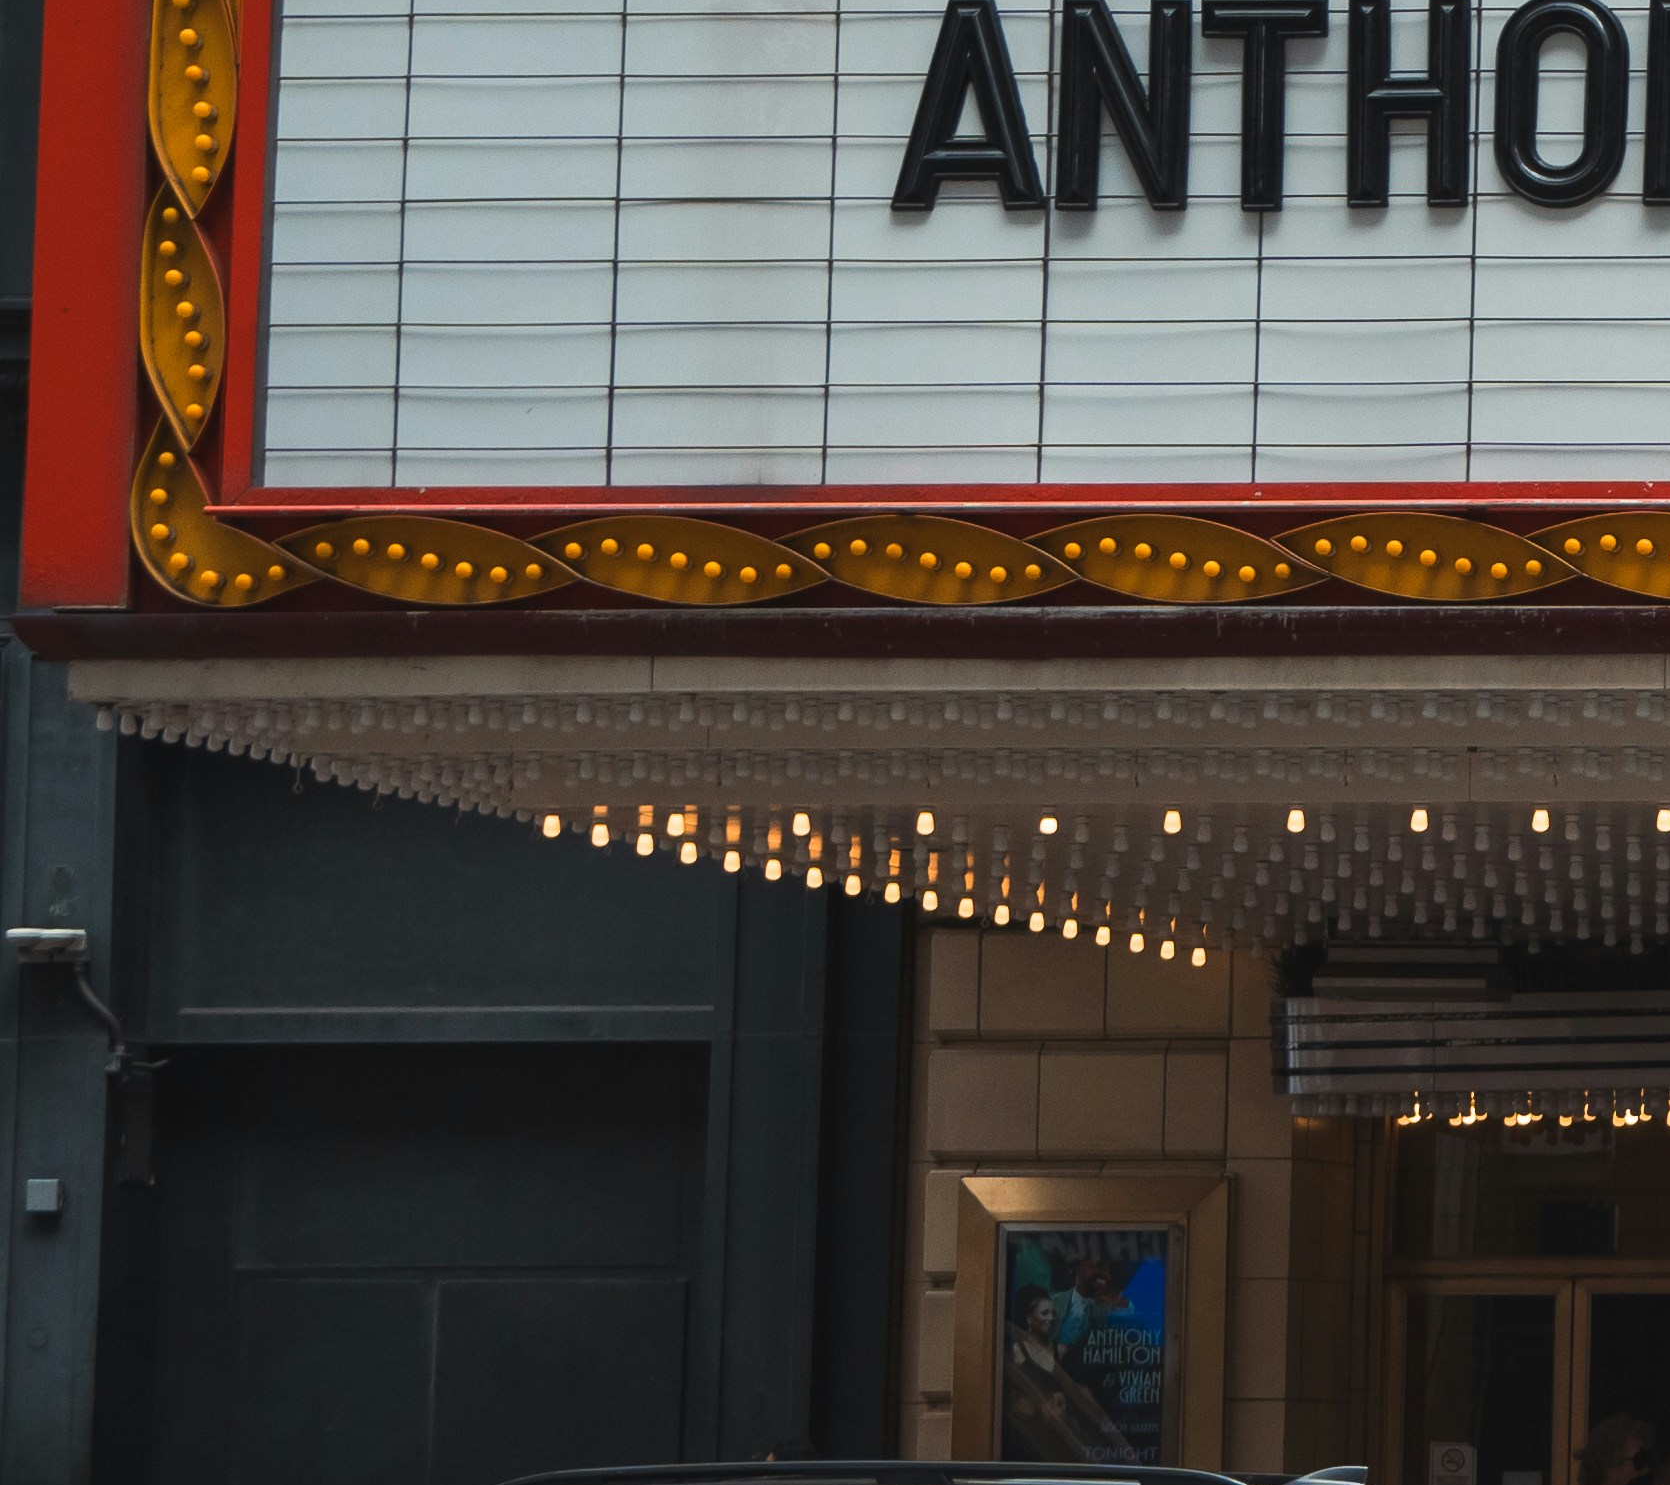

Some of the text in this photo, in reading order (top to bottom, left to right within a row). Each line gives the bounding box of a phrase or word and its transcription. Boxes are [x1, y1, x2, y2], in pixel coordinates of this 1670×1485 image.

[1088, 1328, 1161, 1346] ANTHONY
[1083, 1346, 1160, 1364] HAMILTON
[1120, 1370, 1161, 1387] VIVIAN
[1120, 1386, 1159, 1404] GREEN
[1083, 1447, 1159, 1460] TONIGHT
